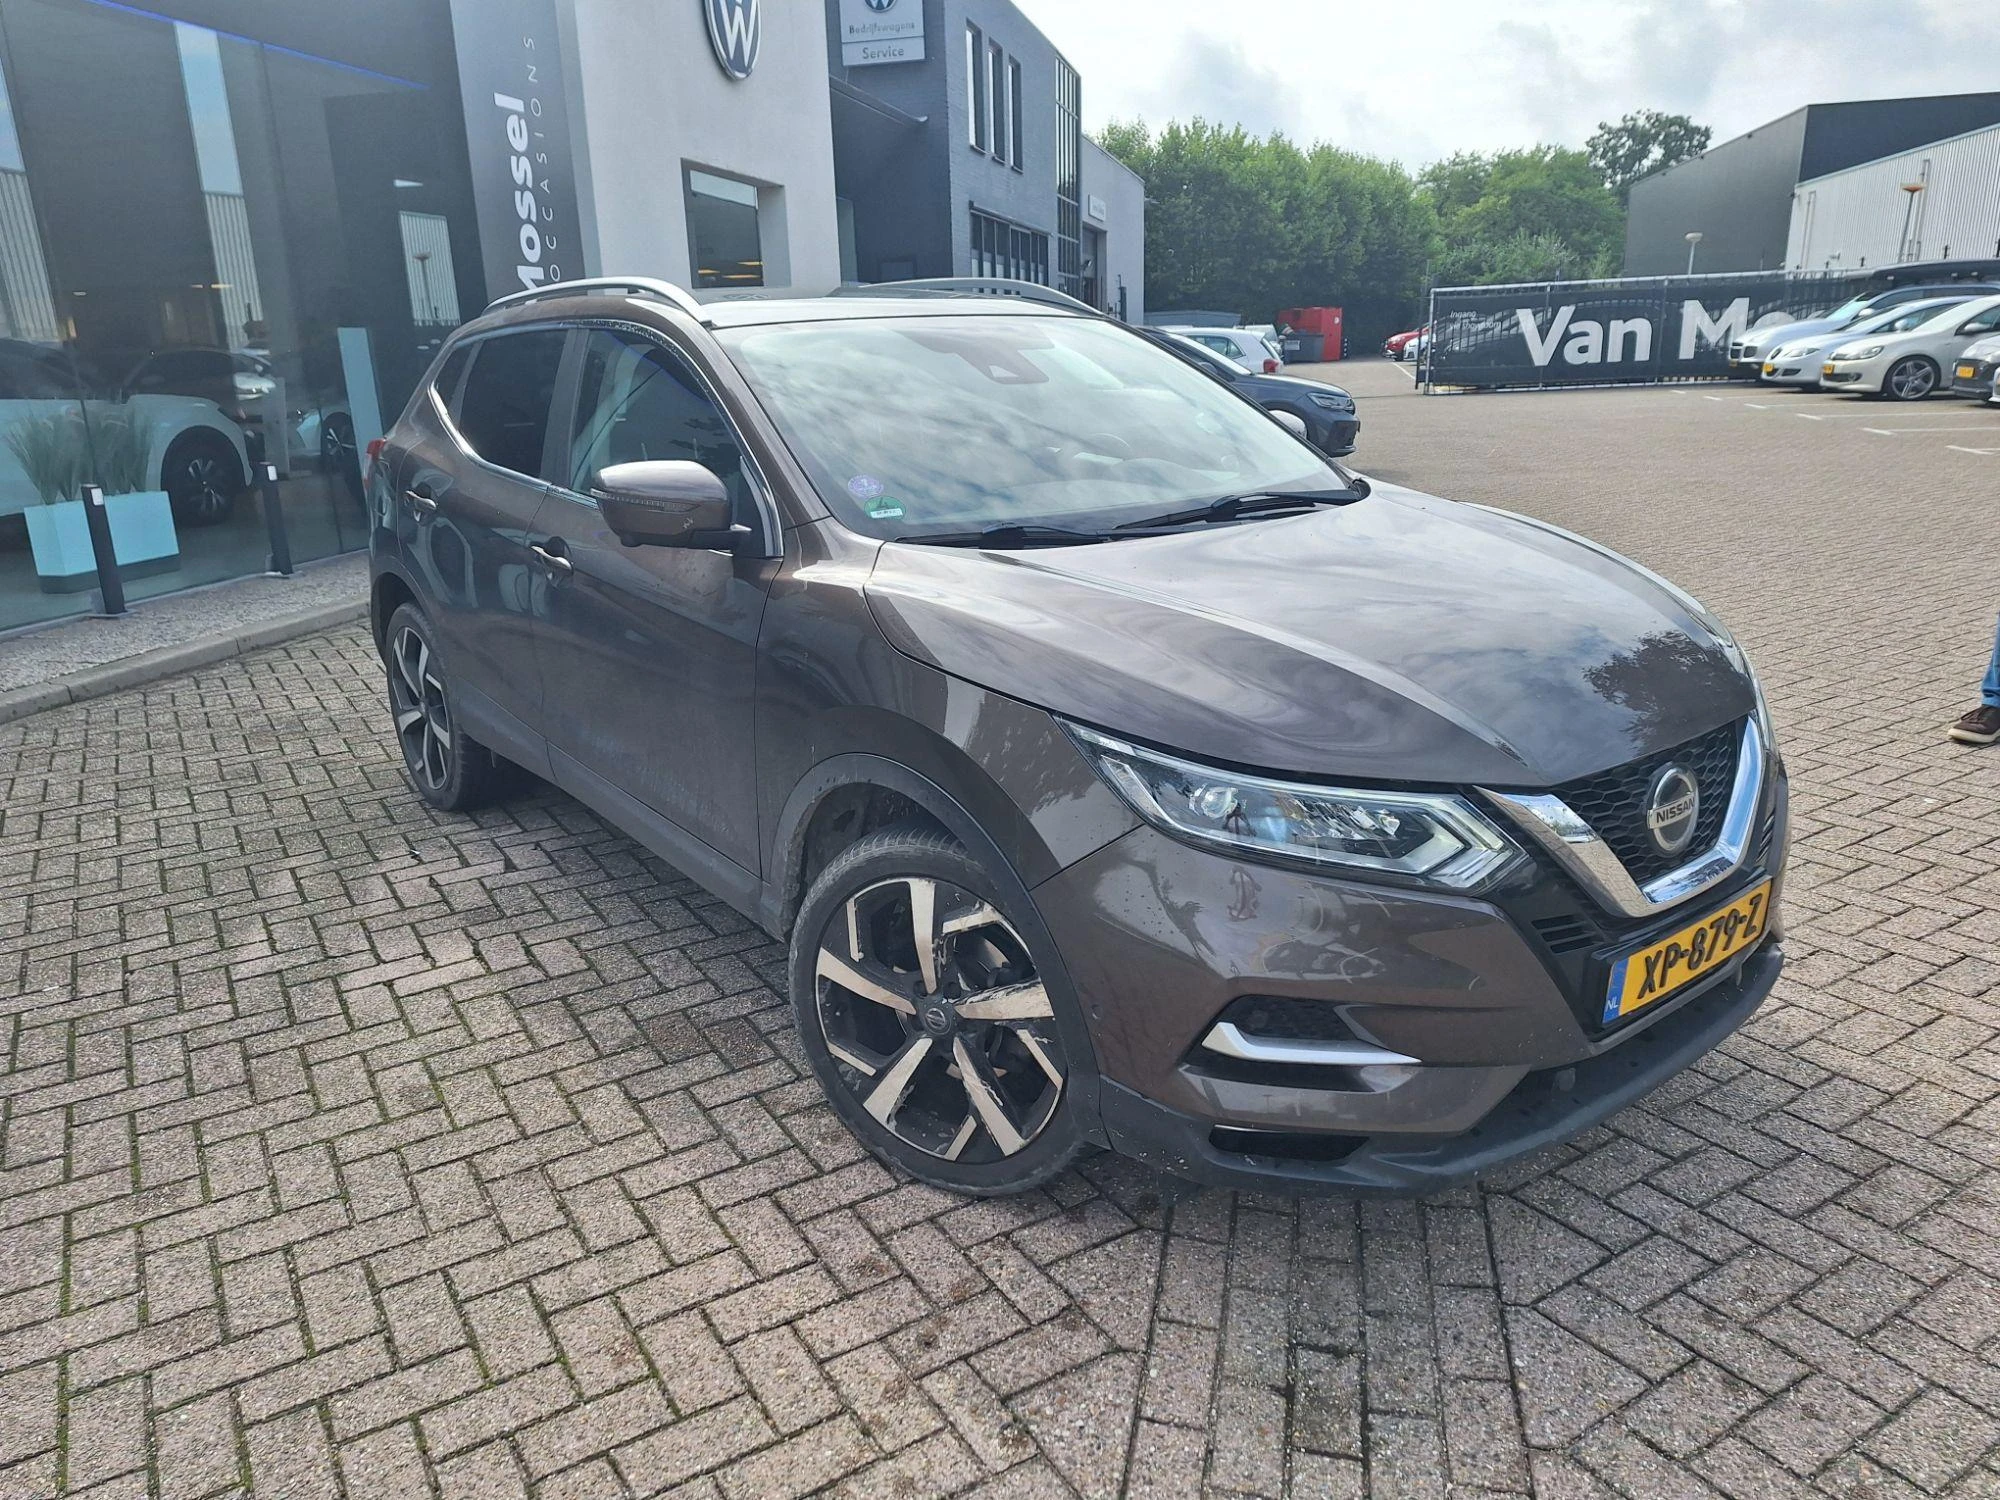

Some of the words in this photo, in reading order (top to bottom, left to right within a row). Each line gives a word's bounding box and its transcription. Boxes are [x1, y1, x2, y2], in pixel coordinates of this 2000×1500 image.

[849, 22, 915, 34] Bedrijfswagens
[862, 46, 905, 60] Service
[523, 36, 561, 282] OCCASIONS
[1515, 304, 1653, 367] Van
[1656, 796, 1695, 824] NISSAN
[1637, 893, 1763, 1000] XP-879-Z
[1605, 996, 1619, 1012] NL
